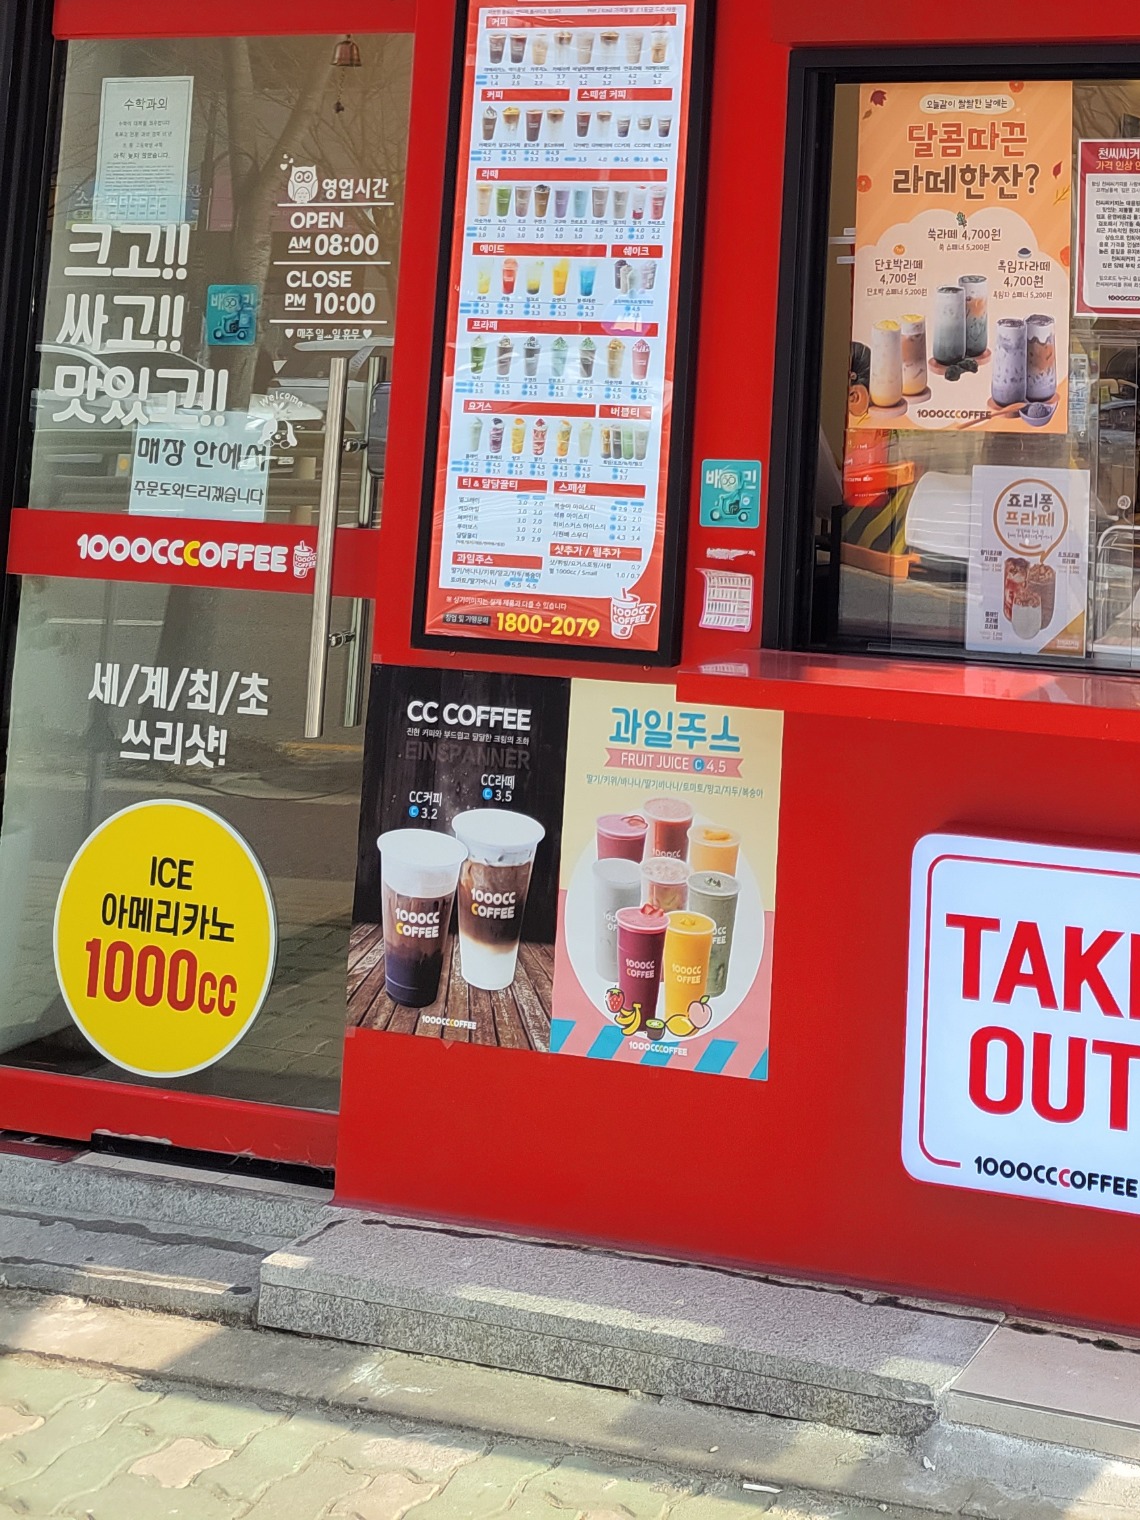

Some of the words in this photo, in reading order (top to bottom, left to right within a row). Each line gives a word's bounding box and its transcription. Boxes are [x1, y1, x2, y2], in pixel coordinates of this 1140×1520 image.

[491, 17, 508, 27] 커피
[123, 97, 168, 111] 수학과외
[486, 90, 503, 100] 커피
[925, 99, 956, 110] 오늘같이
[984, 98, 1008, 109] 날에는
[907, 121, 1029, 158] 달콤따끈
[1095, 160, 1113, 171] 가격
[1115, 160, 1133, 171] 인상
[321, 178, 390, 199] 영업시간
[892, 163, 1040, 200] 라떼한잔?
[290, 211, 344, 229] OPEN
[927, 228, 958, 241] 쑥라떼
[961, 228, 1001, 242] 4,700원
[64, 223, 190, 280] 크고!!
[288, 236, 311, 249] AM
[314, 234, 379, 256] 08:00
[479, 244, 505, 254] 에이드
[874, 258, 923, 271] 단호박라떼
[997, 260, 1051, 274] 흑임자라떼
[286, 270, 352, 288] CLOSE
[879, 272, 917, 286] 4,700원
[1003, 275, 1044, 288] 4,700원
[284, 293, 306, 307] PM
[313, 292, 376, 315] 10:00
[56, 293, 184, 352] 싸고!!
[297, 328, 314, 340] 매주
[53, 366, 228, 427] 맛있고!!
[916, 408, 992, 420] 1000CCCOFFEE
[137, 437, 186, 466] 매장
[193, 439, 267, 471] 안에서
[133, 480, 265, 505] 주문도와드리겠습니다
[1006, 493, 1053, 512] 죠리퐁
[1004, 511, 1055, 527] 프라페
[77, 533, 289, 573] 1000CCCOFFEE
[456, 553, 494, 564] 과일주스
[496, 612, 600, 638] 1800-2079
[87, 662, 270, 717] 세/계/최/초
[407, 700, 440, 723] CC
[442, 703, 532, 731] COFFEE
[608, 706, 741, 753] 과일주스
[119, 718, 228, 768] 쓰리샷!
[404, 740, 531, 771] EINSPANNER
[620, 751, 654, 767] FRUIT
[656, 755, 689, 771] JUICE
[706, 759, 727, 774] 4.5
[480, 773, 515, 790] CC라떼
[408, 790, 442, 807] CC커피
[494, 789, 513, 802] 3.5
[420, 807, 438, 820] 3.2
[150, 856, 194, 891] ICE
[470, 887, 516, 905] 1000CC
[101, 892, 236, 943] 아메리카노
[395, 907, 440, 925] 1000CC
[471, 902, 515, 920] COFFEE
[395, 922, 440, 939] COFFEE
[625, 958, 655, 970] 1000CC
[85, 938, 238, 1018] 1000cc
[421, 1014, 477, 1030] 1000CCCOFFEE
[974, 1155, 1139, 1199] 1000CCCOFFEE
